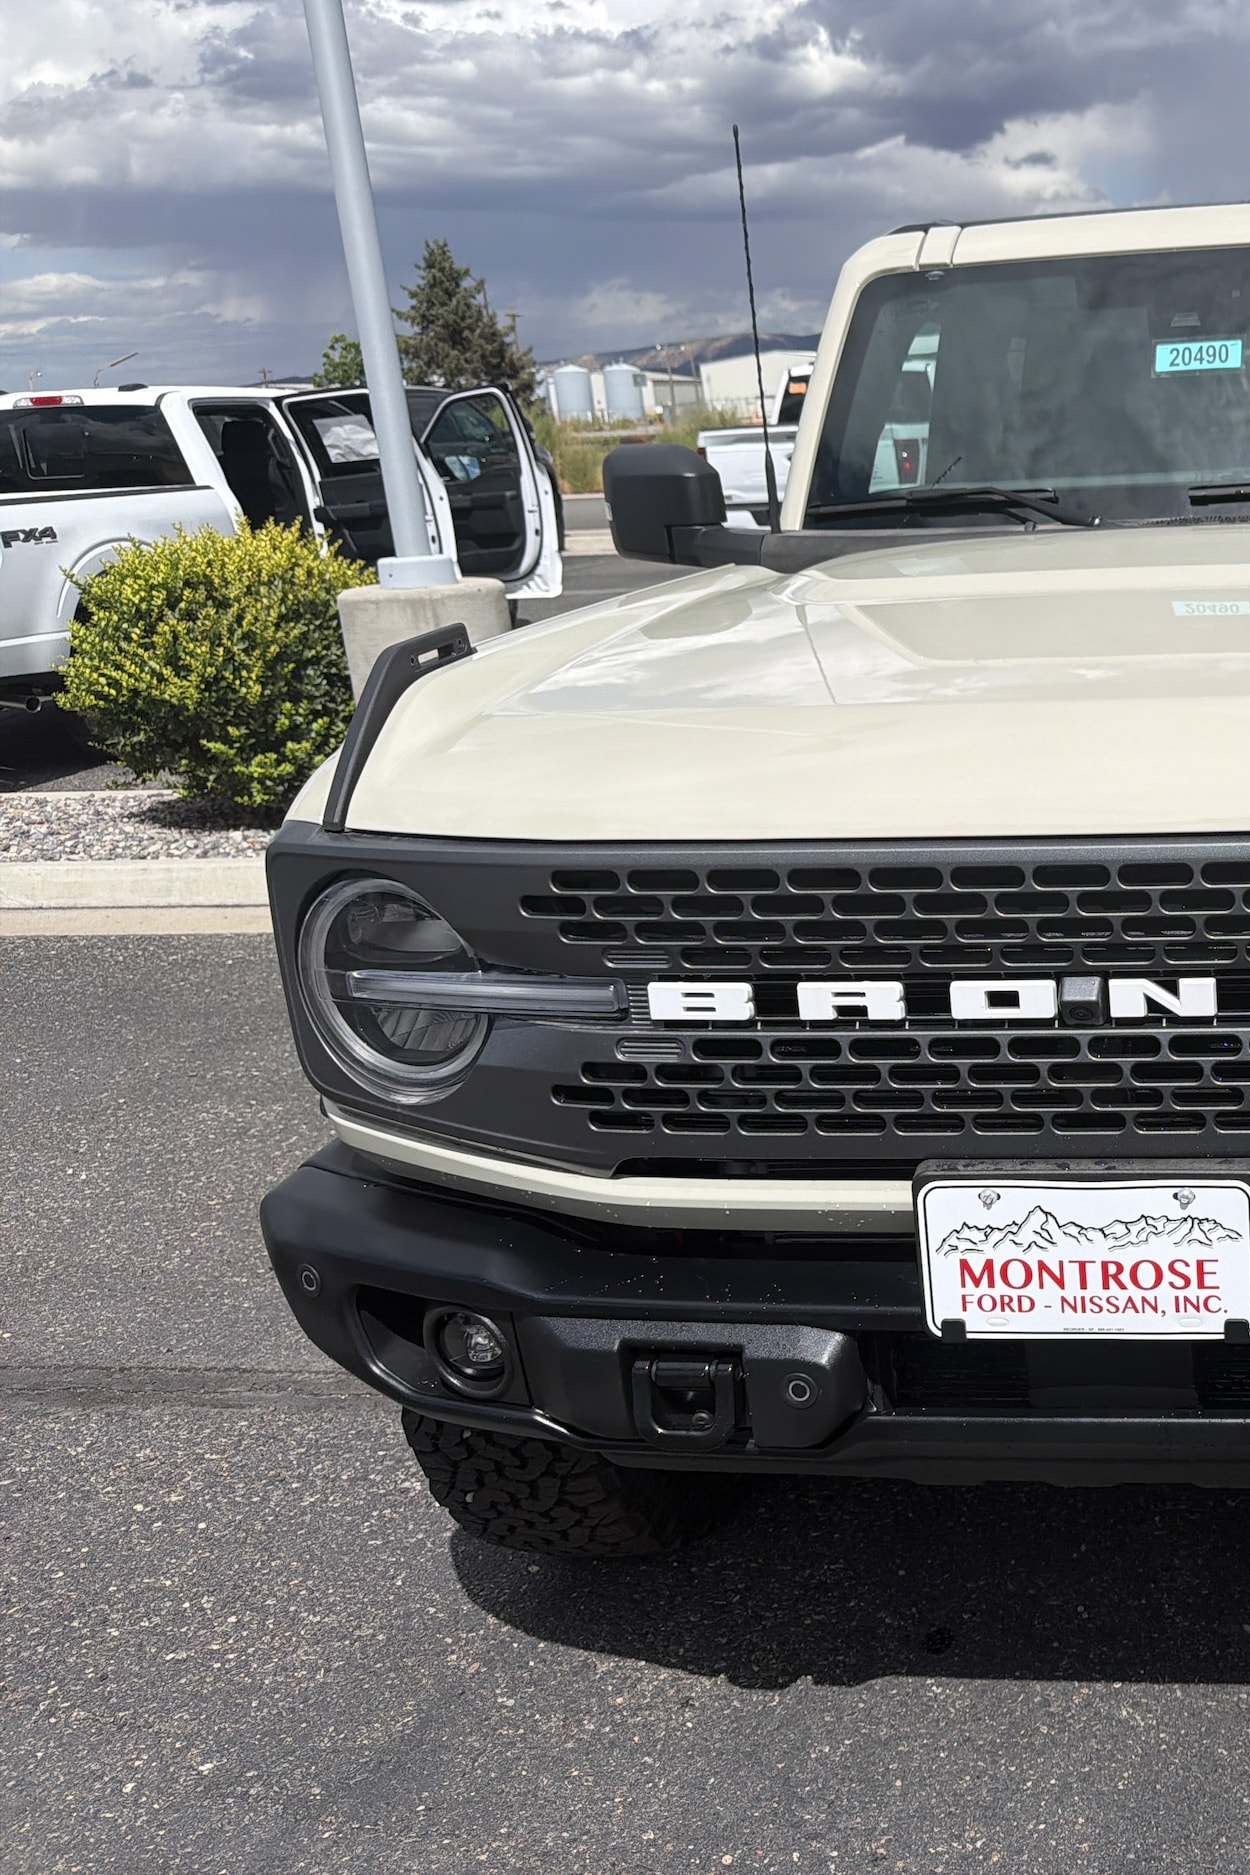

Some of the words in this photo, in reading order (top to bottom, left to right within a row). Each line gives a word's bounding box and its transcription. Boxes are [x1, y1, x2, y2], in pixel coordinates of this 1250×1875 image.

[1169, 344, 1229, 368] 20490
[0, 526, 58, 549] FX4
[959, 1258, 1221, 1291] MONTROSE
[961, 1293, 1036, 1313] FORD
[1061, 1295, 1167, 1318] NISSAN,
[1174, 1295, 1229, 1314] INC.
